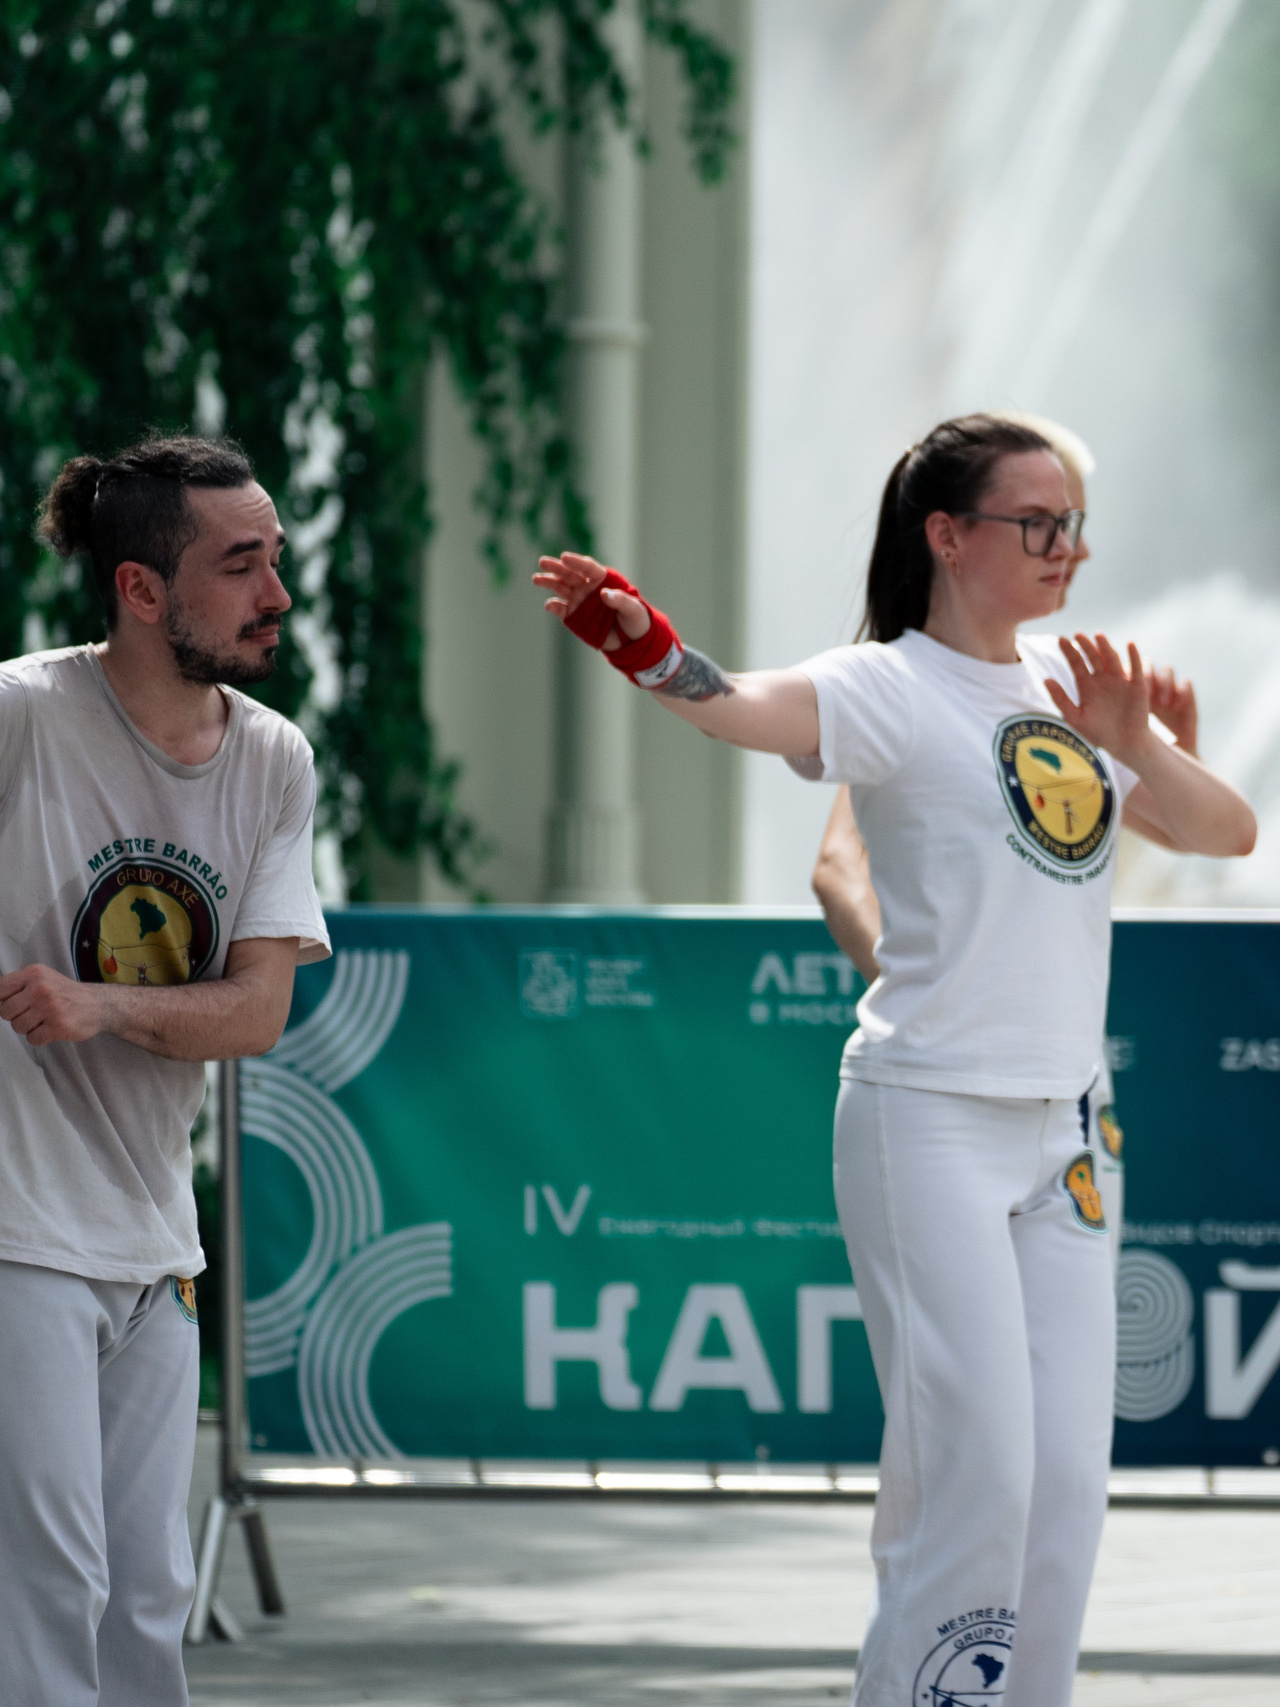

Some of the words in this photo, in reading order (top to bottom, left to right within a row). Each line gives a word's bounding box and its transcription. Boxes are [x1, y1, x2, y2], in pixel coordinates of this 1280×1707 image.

[1006, 833, 1083, 885] CONTRAMESTRE
[1028, 820, 1069, 859] MESTRE
[87, 838, 156, 873] MESTRE
[162, 842, 228, 900] BARRÃO
[116, 868, 165, 886] GRUPO
[752, 952, 857, 995] ЛЕТ
[524, 1184, 592, 1237] IV
[937, 1608, 994, 1637] MESTRE
[954, 1627, 1005, 1650] GRUPO
